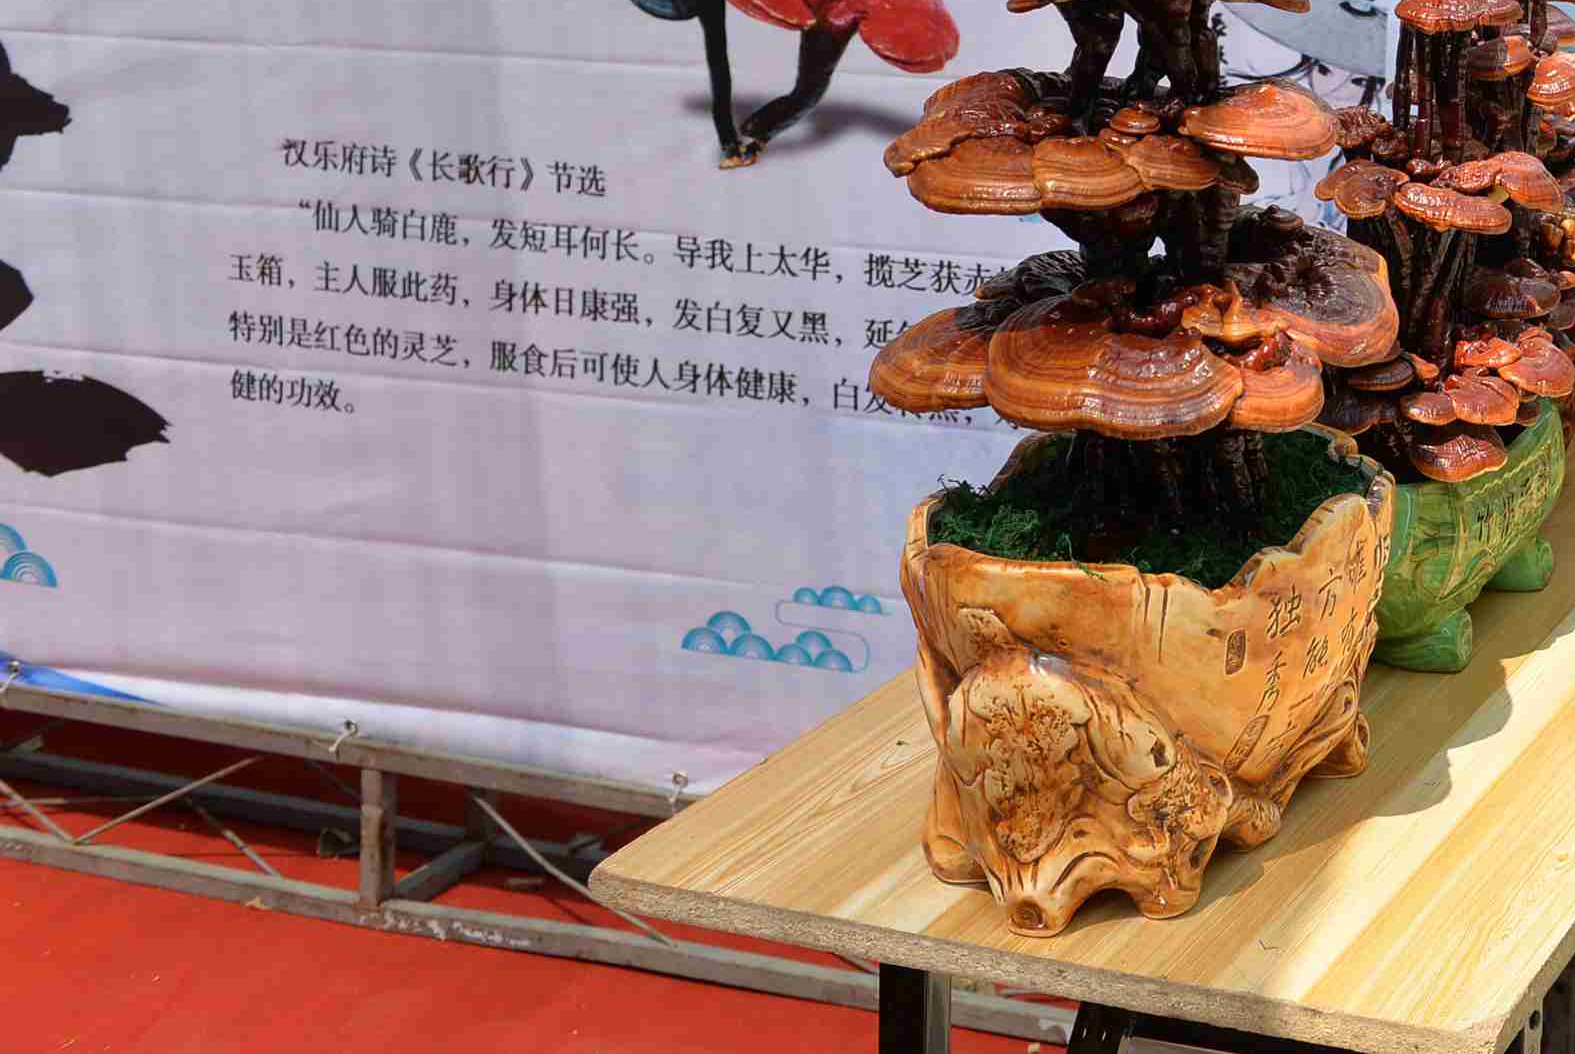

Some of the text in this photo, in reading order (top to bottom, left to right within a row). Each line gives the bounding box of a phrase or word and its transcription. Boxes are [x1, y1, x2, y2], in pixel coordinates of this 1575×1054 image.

[299, 198, 1009, 297] “仙人骑白鹿，发短耳何长。导我上太华，揽芝获赤
[229, 310, 1018, 430] 特别是红色的灵芝，服食后可使人身体健康，白发，
[231, 369, 355, 414] 健的功效。
